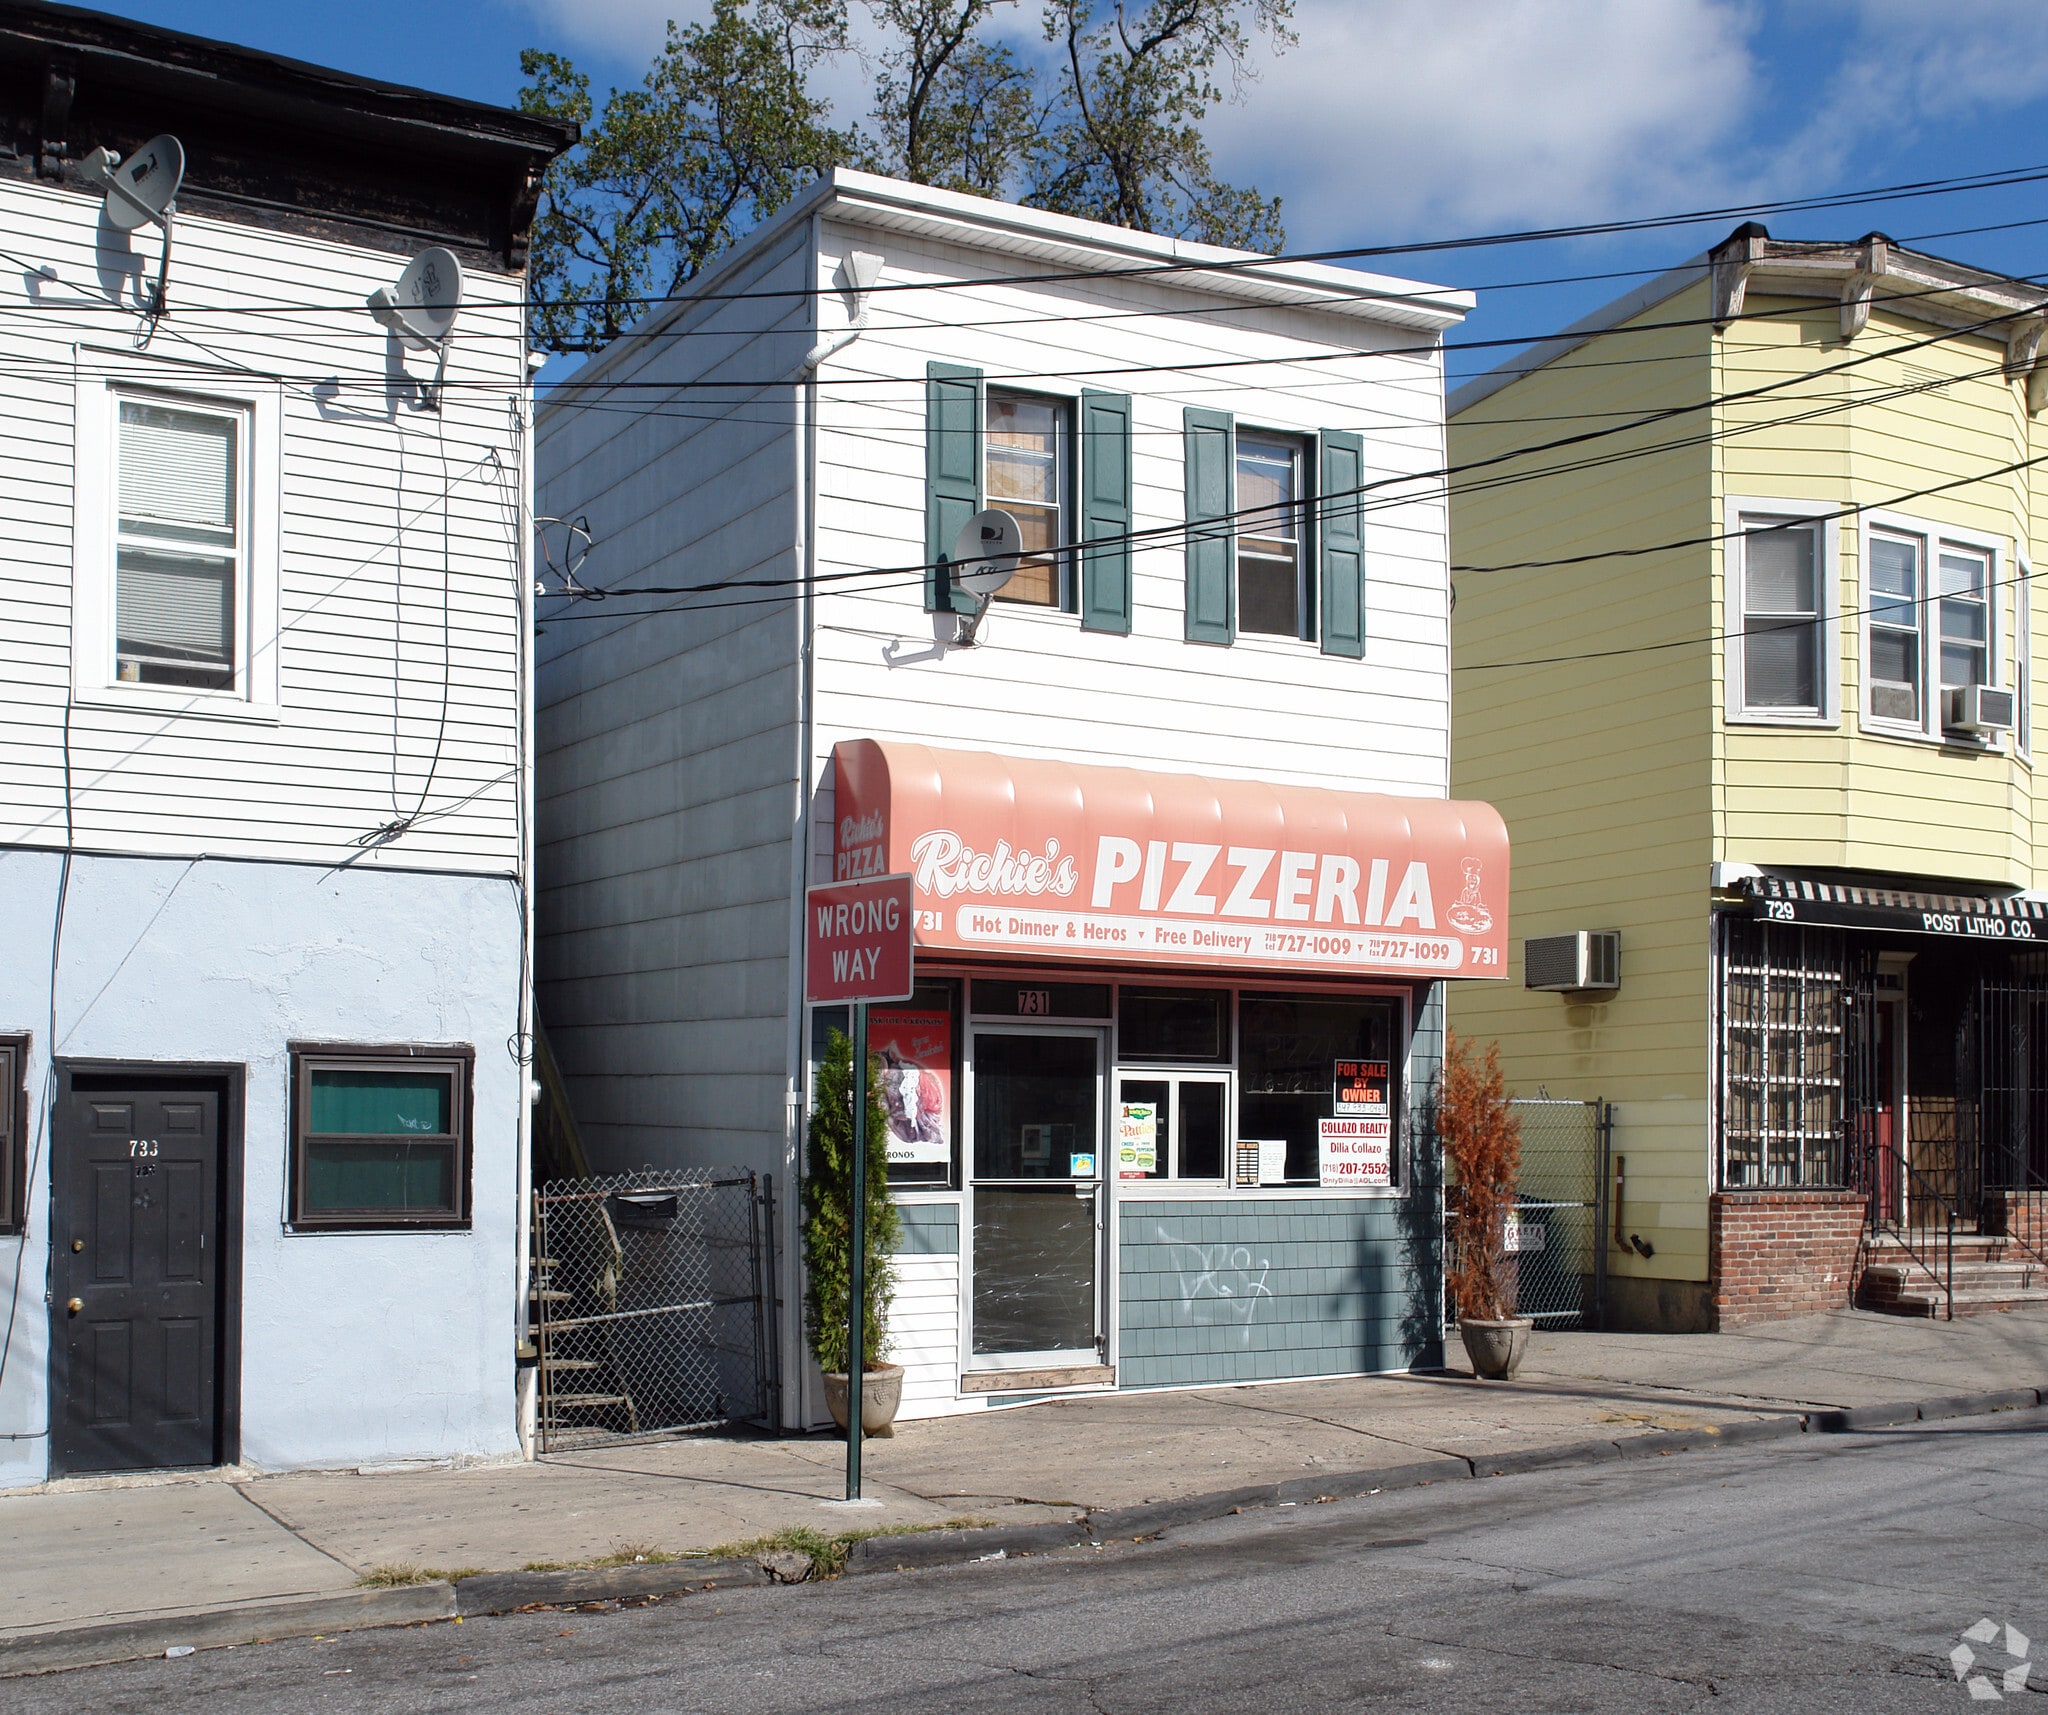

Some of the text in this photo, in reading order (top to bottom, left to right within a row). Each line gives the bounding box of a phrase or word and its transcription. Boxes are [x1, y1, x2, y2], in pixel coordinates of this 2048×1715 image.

[841, 808, 884, 849] Richie's
[837, 844, 885, 880] PIZZA
[911, 829, 1437, 930] Richie's PIZZERIA
[817, 897, 900, 938] WRONG
[1765, 900, 1795, 920] 729
[972, 915, 1127, 941] Hot Dinner & Heros
[1922, 913, 2036, 938] POST LITHO CO.
[1155, 926, 1252, 953] Free Delivery
[1265, 932, 1276, 942] 718
[1277, 934, 1352, 955] 727-1009
[1369, 940, 1380, 948] 718
[1265, 943, 1275, 951] tel
[1369, 948, 1380, 957] fax
[1380, 940, 1450, 960] 727-1099
[832, 946, 881, 983] WAY
[1471, 947, 1498, 965] 731
[1019, 992, 1047, 1013] 731
[1337, 1062, 1387, 1077] FOR SALE
[1354, 1077, 1369, 1089] BY
[1342, 1088, 1381, 1102] OWNER
[1119, 1122, 1155, 1137] Patties
[1321, 1121, 1388, 1134] COLLAZO REALTY
[129, 1140, 159, 1157] 733
[886, 1151, 915, 1159] RONOS
[1330, 1142, 1382, 1154] Dilia Collazo
[1322, 1163, 1387, 1175] (718) 207-2552
